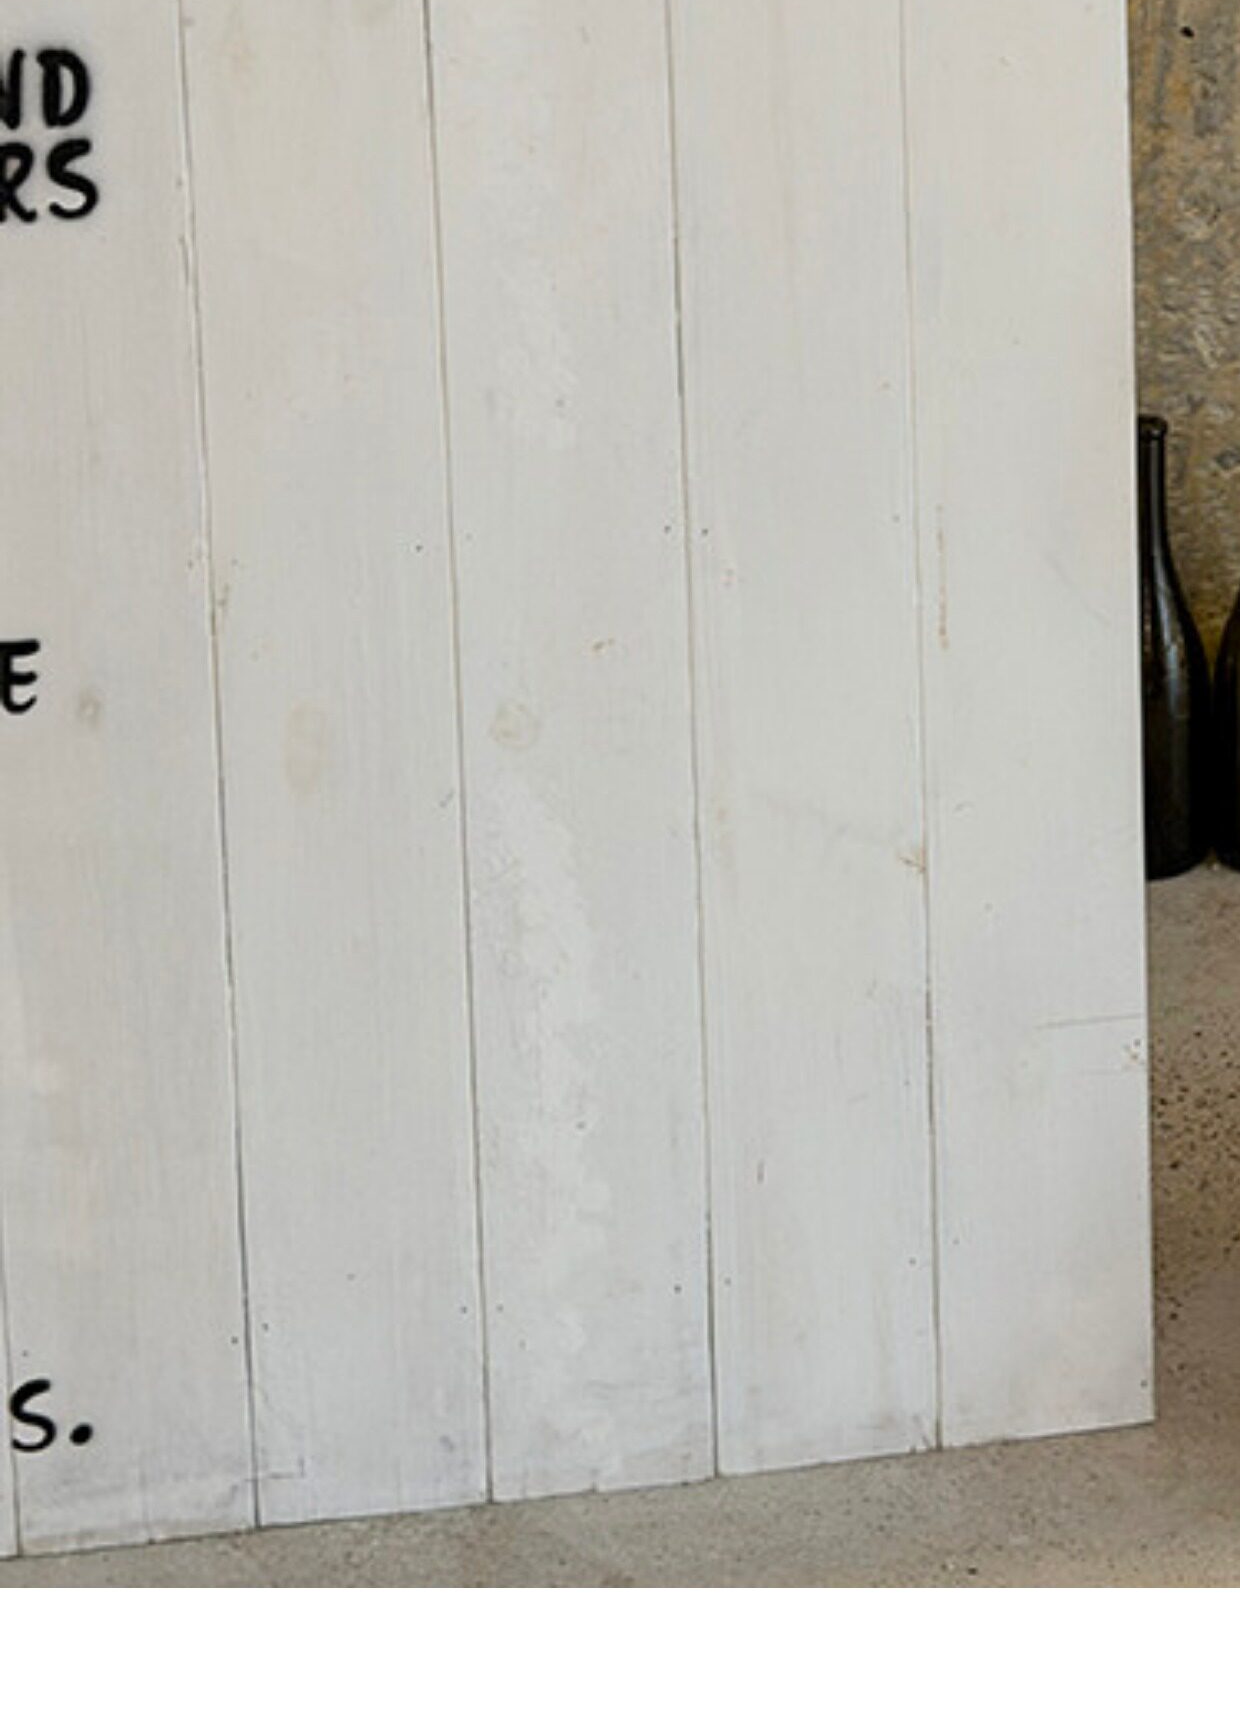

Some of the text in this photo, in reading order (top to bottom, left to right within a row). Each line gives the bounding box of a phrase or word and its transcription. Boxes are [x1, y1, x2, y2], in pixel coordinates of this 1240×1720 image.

[0, 137, 99, 223] RS
[0, 639, 40, 714] E
[9, 1379, 93, 1452] S.
